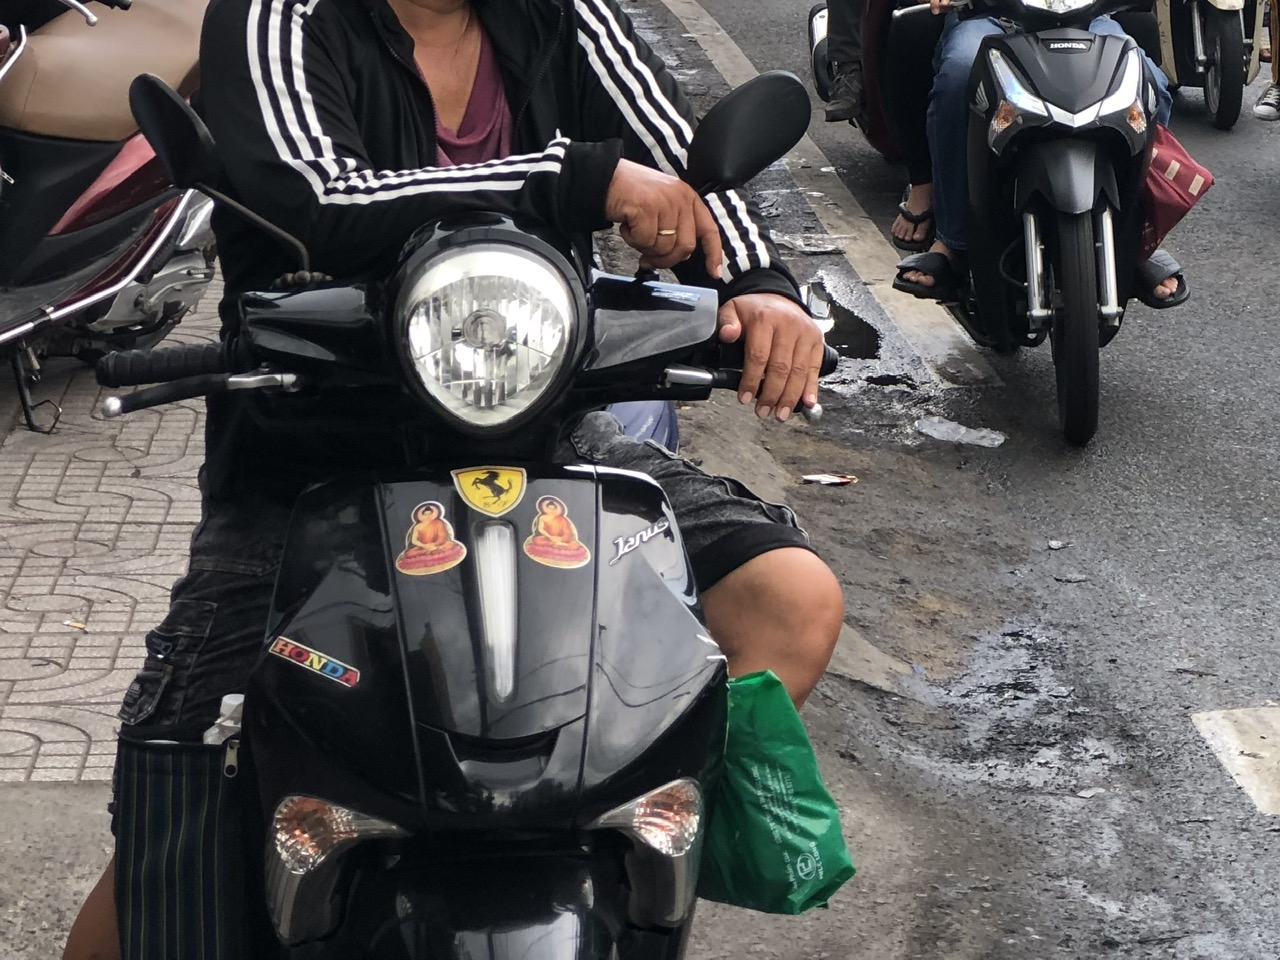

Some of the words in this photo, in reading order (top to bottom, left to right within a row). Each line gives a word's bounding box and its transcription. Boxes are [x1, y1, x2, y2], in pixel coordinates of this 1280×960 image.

[1050, 42, 1087, 50] HONDA
[609, 518, 670, 567] Janus
[272, 640, 357, 688] HONDA
